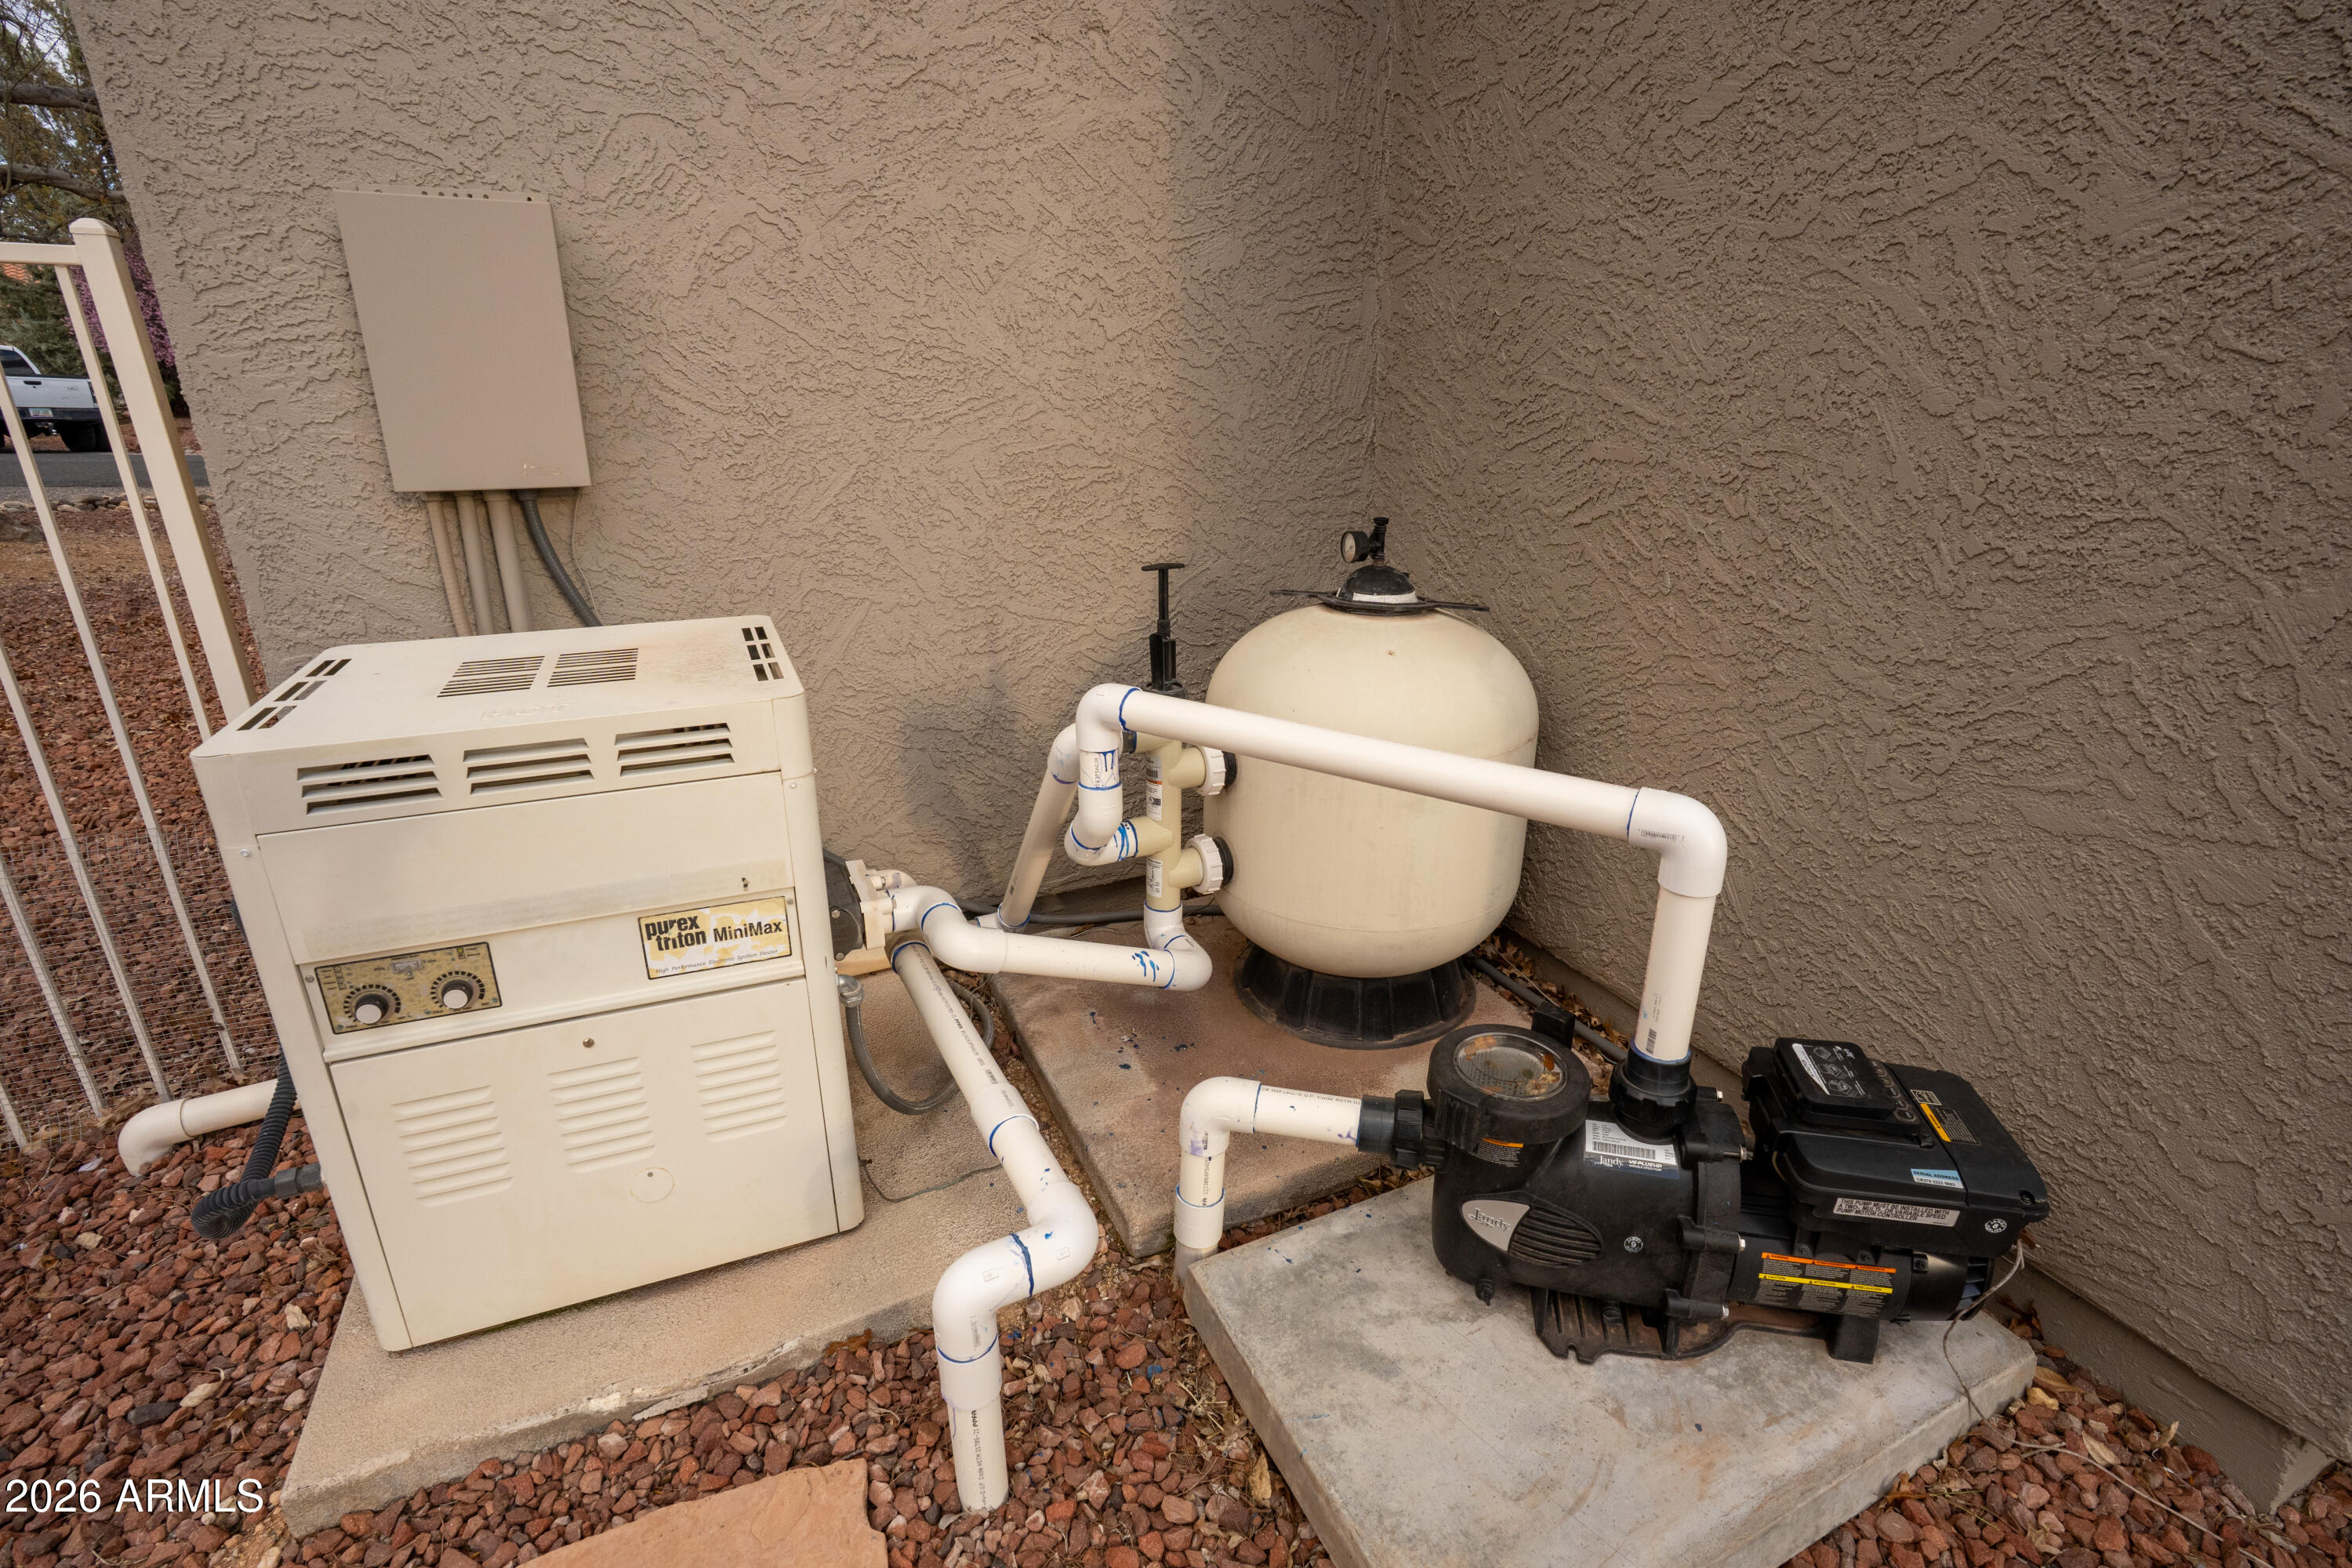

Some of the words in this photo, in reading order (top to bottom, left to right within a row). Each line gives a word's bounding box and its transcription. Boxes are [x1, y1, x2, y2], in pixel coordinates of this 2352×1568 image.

[644, 916, 700, 941] purex
[713, 921, 783, 942] MiniMax
[655, 930, 706, 952] triton
[671, 962, 706, 971] Performance
[737, 953, 757, 961] Ignition
[1596, 1155, 1624, 1167] Jandy
[1878, 1212, 1918, 1221] CONTROLLER
[1900, 1205, 1933, 1214] INSTALLED
[1471, 1207, 1511, 1232] Jandy
